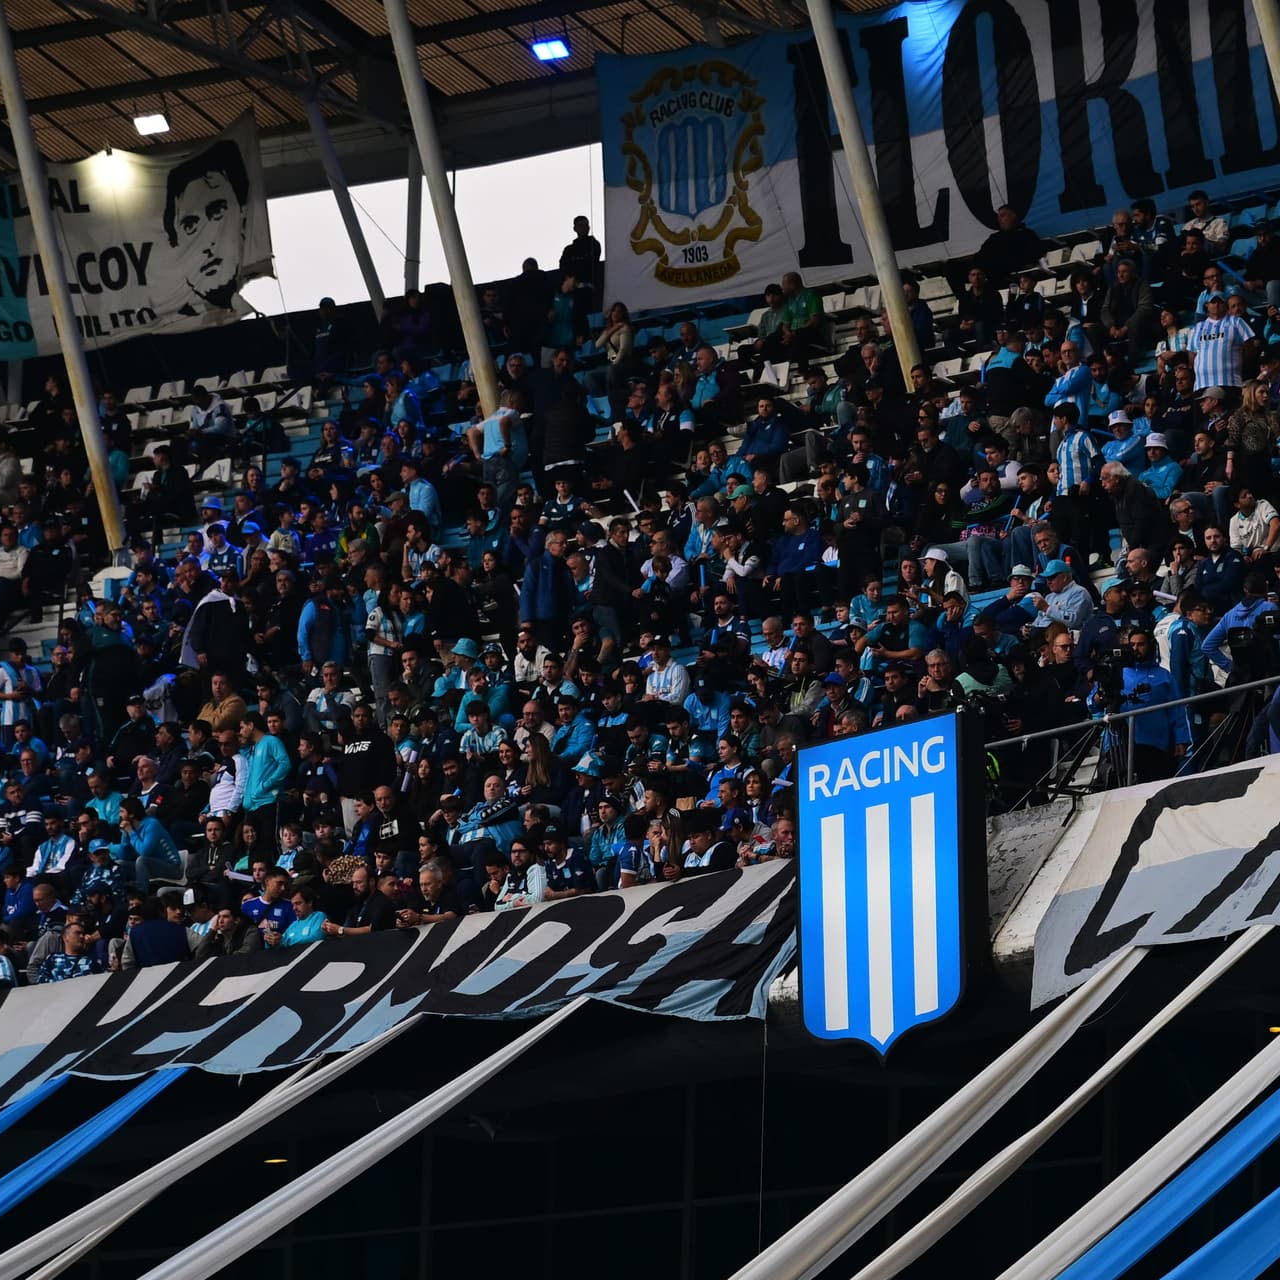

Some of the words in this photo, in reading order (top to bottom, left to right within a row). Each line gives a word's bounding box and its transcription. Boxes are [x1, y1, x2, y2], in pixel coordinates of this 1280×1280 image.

[699, 92, 736, 118] CLUB
[680, 246, 710, 264] 1903
[53, 306, 157, 339] ILITO
[808, 735, 946, 802] RACING
